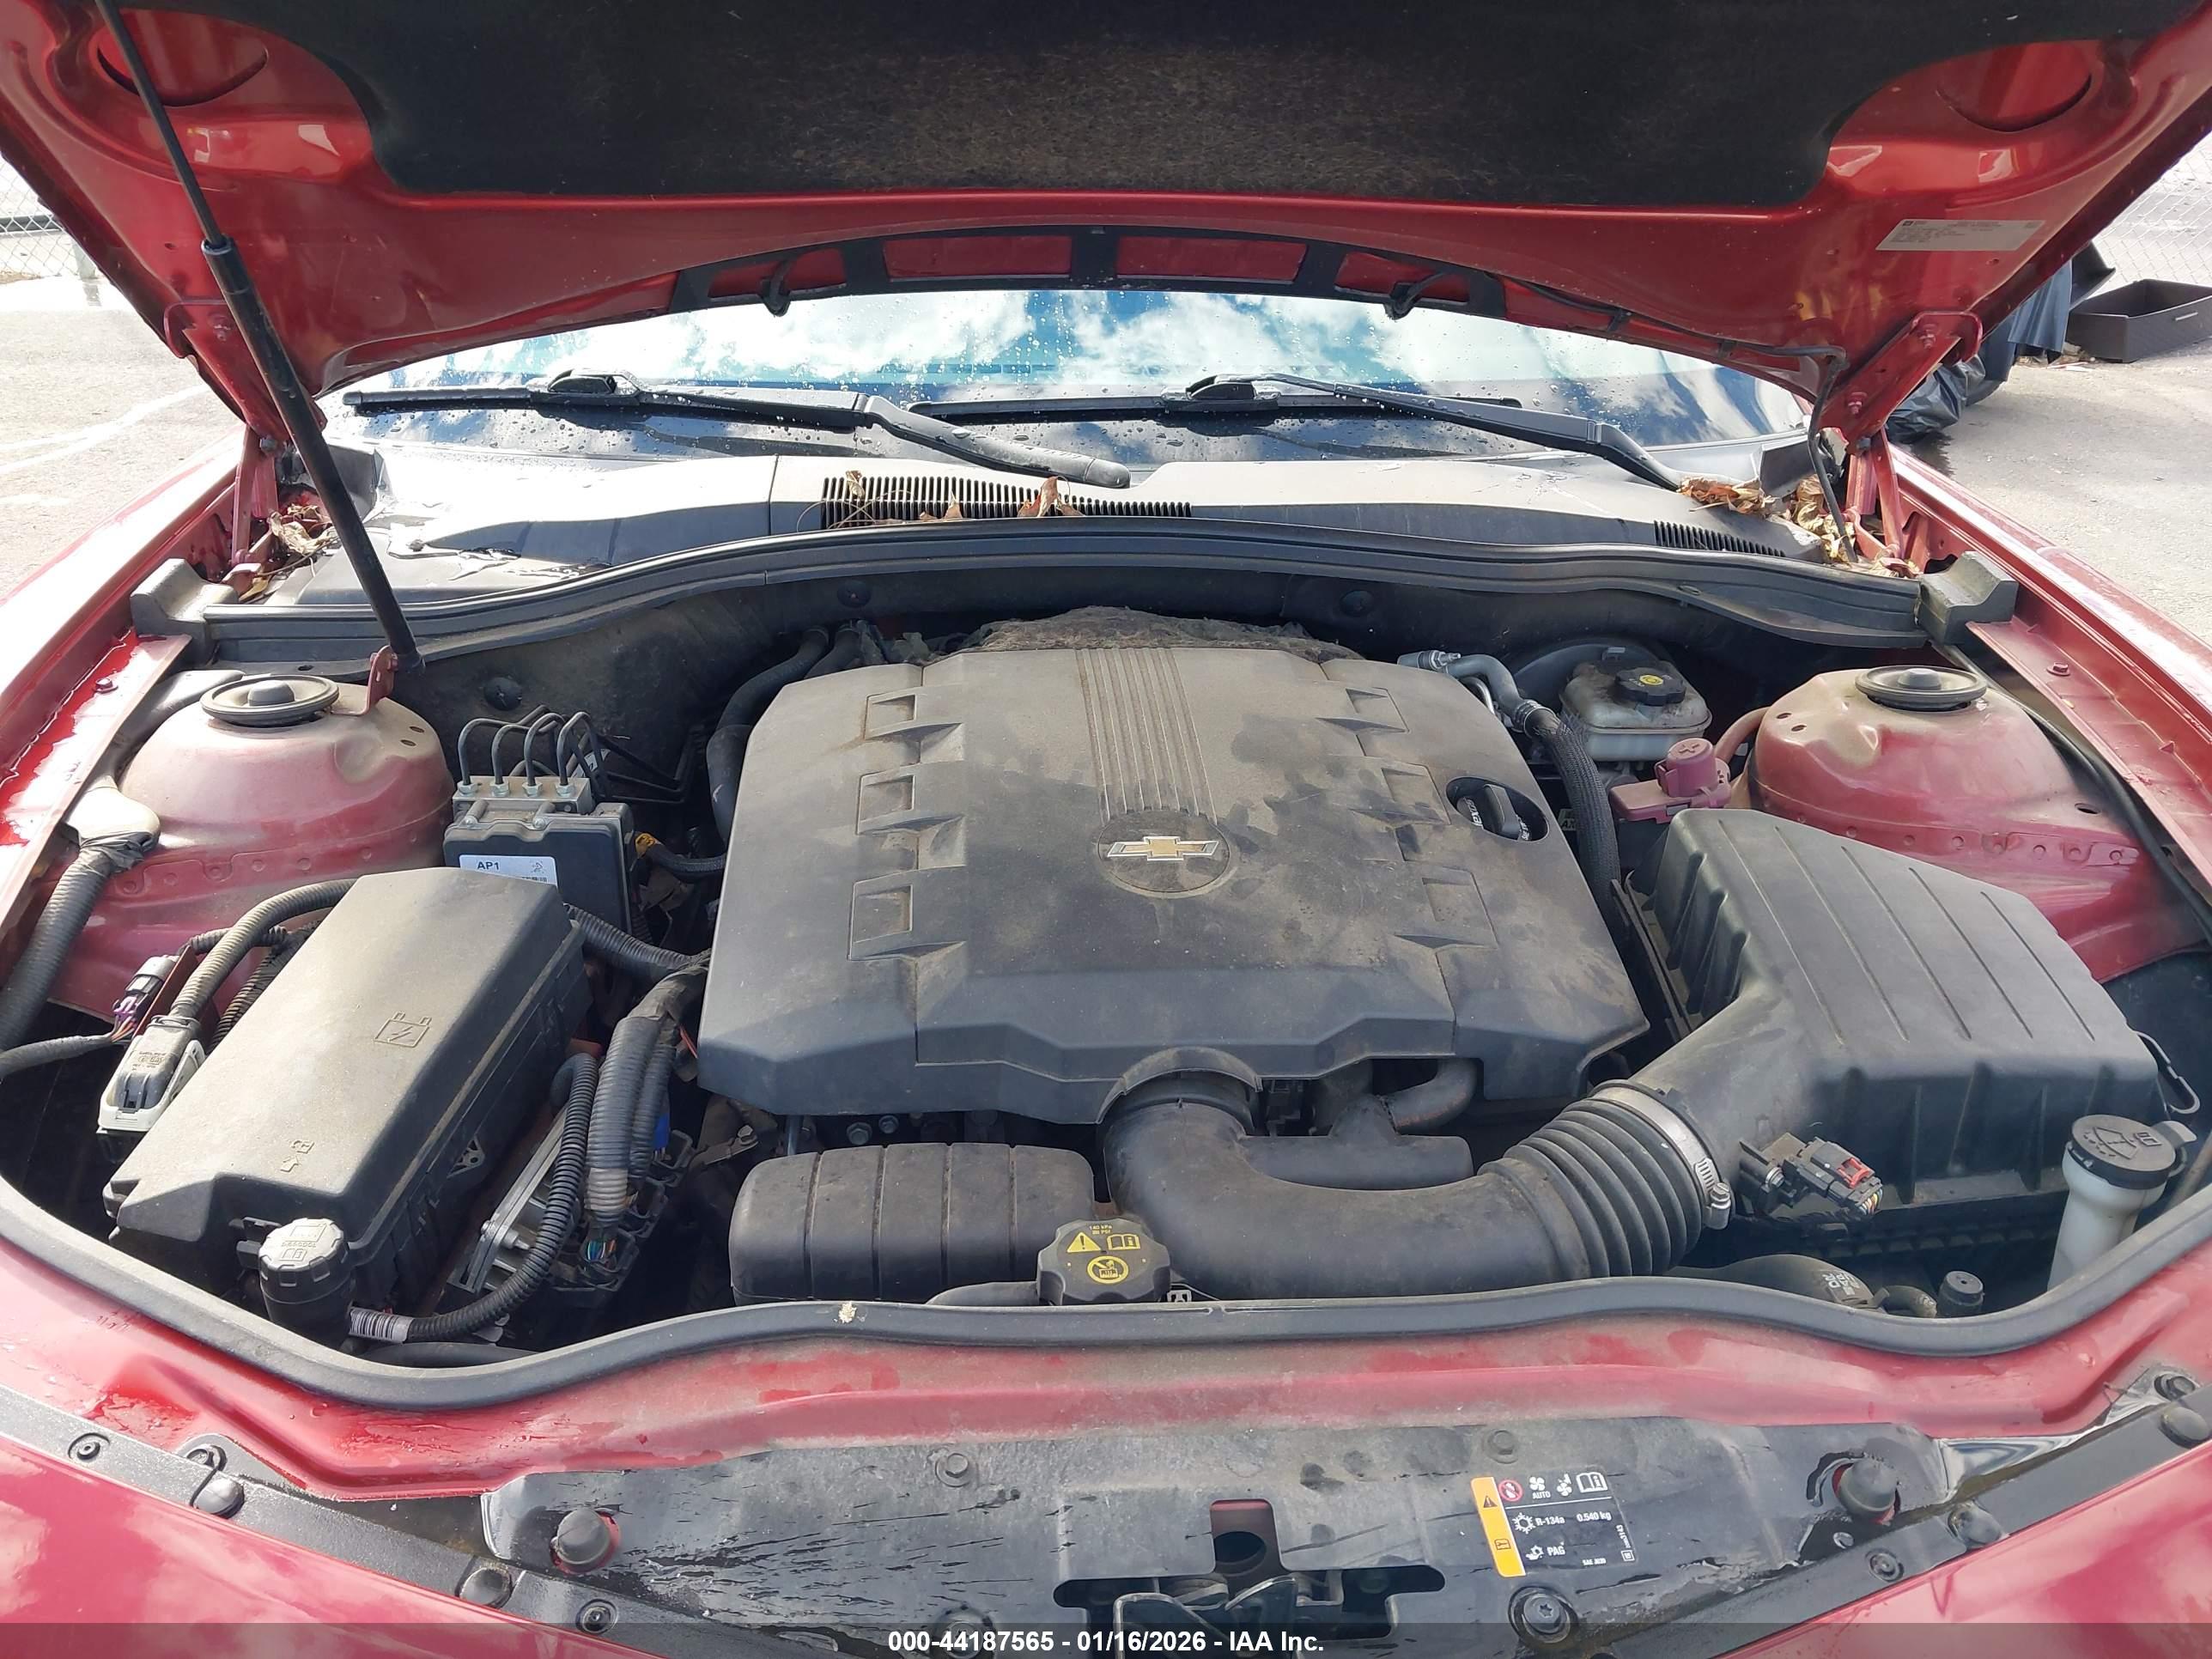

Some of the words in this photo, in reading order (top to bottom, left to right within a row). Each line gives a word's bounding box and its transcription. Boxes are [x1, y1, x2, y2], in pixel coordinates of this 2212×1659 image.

[477, 860, 500, 871] AP1
[1532, 1490, 1551, 1499] AUTO
[1534, 1516, 1565, 1527] R-134a
[1576, 1511, 1599, 1522] 0.540
[1600, 1510, 1612, 1521] kg
[1547, 1546, 1566, 1557] PAG
